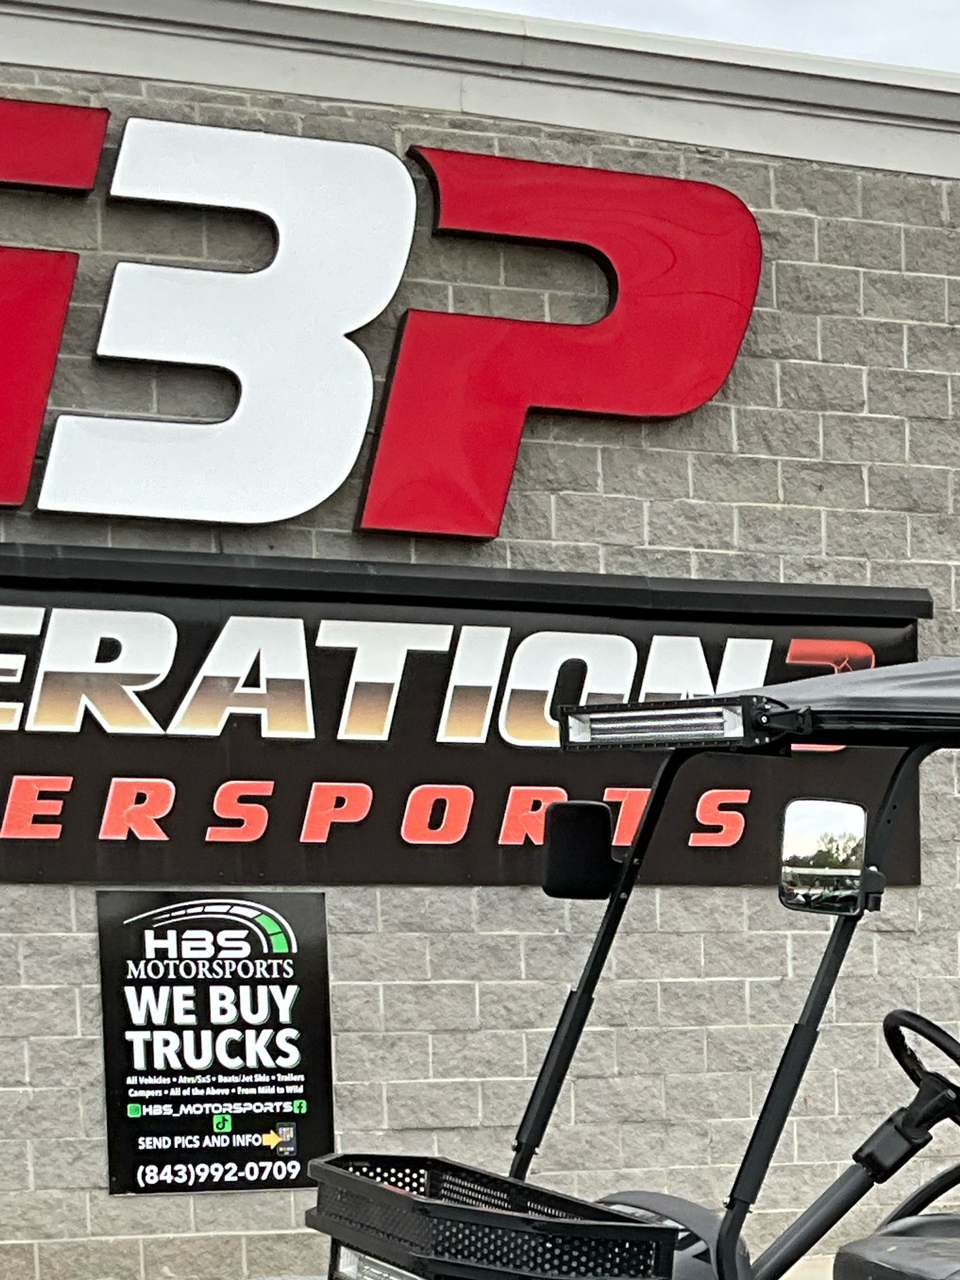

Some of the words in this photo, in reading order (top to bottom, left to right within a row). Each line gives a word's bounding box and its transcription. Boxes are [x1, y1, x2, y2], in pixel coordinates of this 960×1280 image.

[144, 929, 251, 959] HBS
[126, 959, 294, 979] MOTORSPORTS
[123, 985, 198, 1026] WE
[209, 984, 301, 1026] BUY
[124, 1027, 302, 1071] TRUCKS
[138, 1075, 171, 1085] Vehicles
[128, 1088, 163, 1099] Campers
[142, 1101, 294, 1117] HBS_MOTORSPORTS
[137, 1136, 172, 1150] SEND
[173, 1135, 200, 1149] PICS
[202, 1134, 230, 1148] AND
[232, 1133, 262, 1147] INFO
[136, 1160, 301, 1188] (843)992-0709
